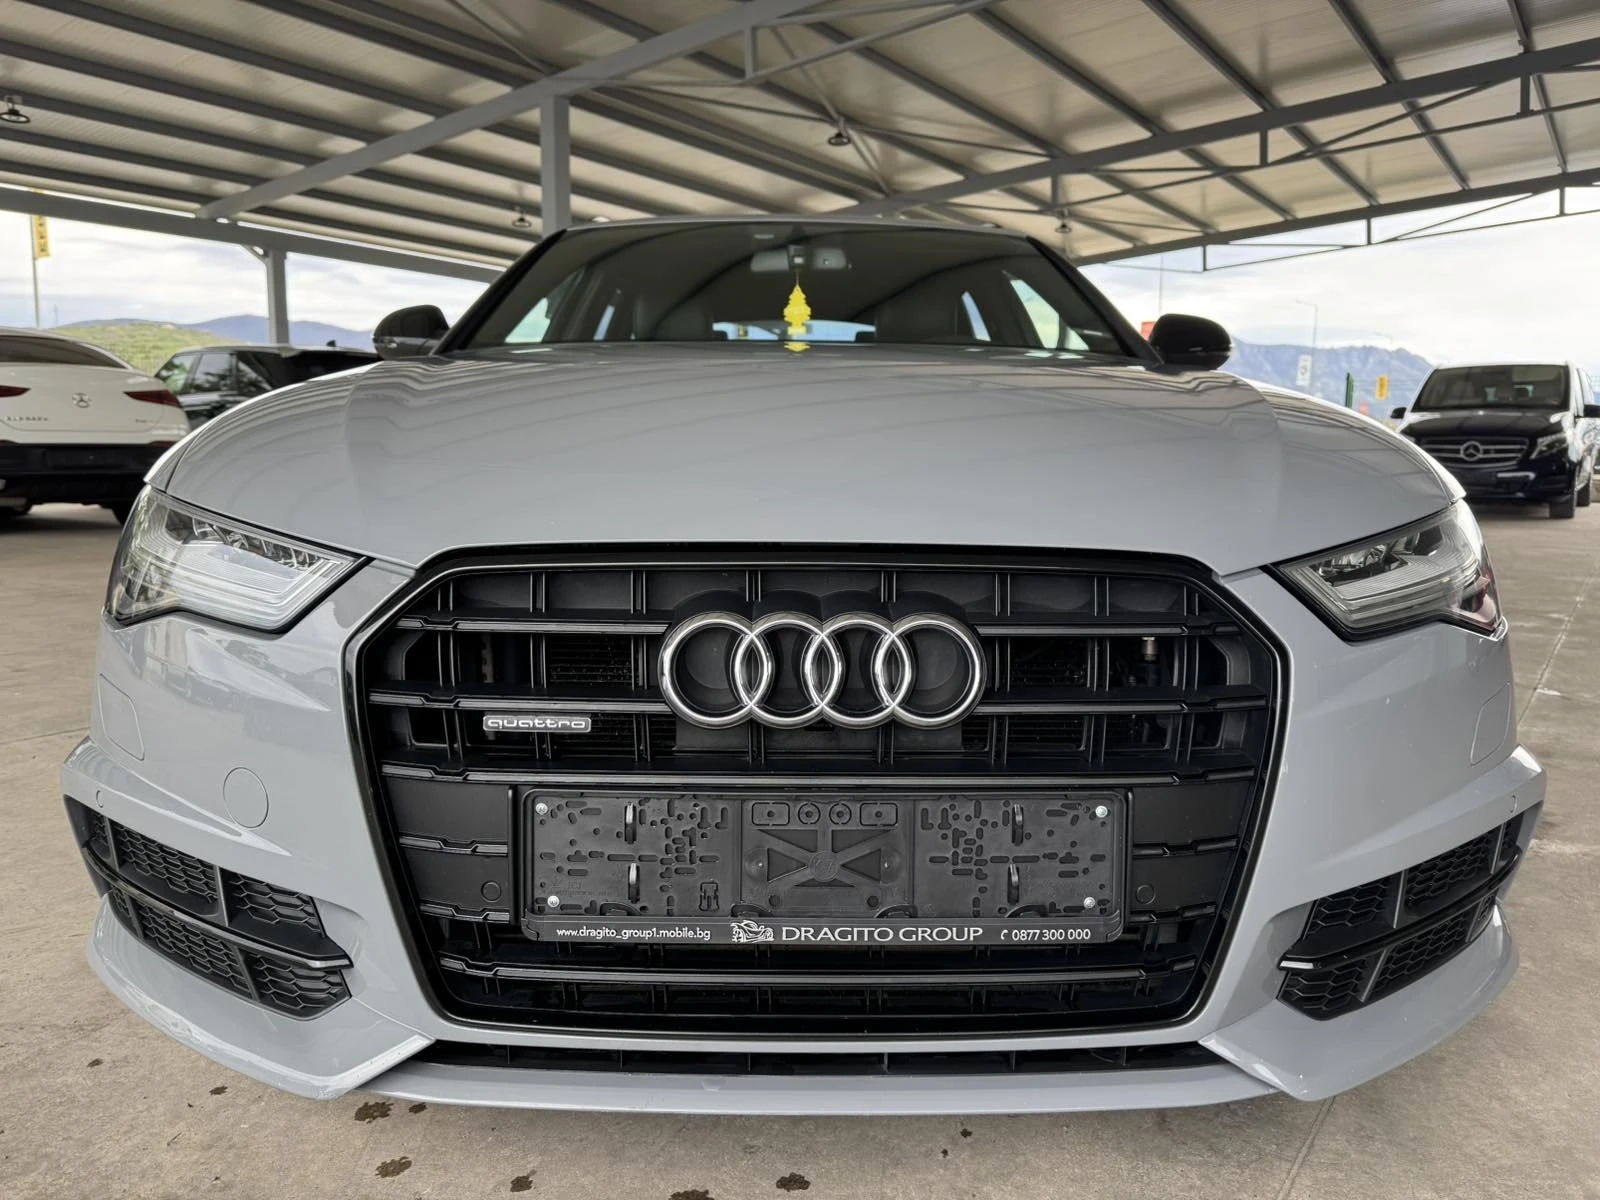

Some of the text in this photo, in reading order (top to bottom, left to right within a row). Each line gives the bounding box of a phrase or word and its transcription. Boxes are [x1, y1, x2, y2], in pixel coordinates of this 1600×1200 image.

[487, 719, 586, 729] quattro
[556, 926, 711, 941] www.dragito_group1.mobile.bg
[782, 927, 983, 942] DRAGITO GROUP
[1012, 929, 1091, 941] 0877 300 000
